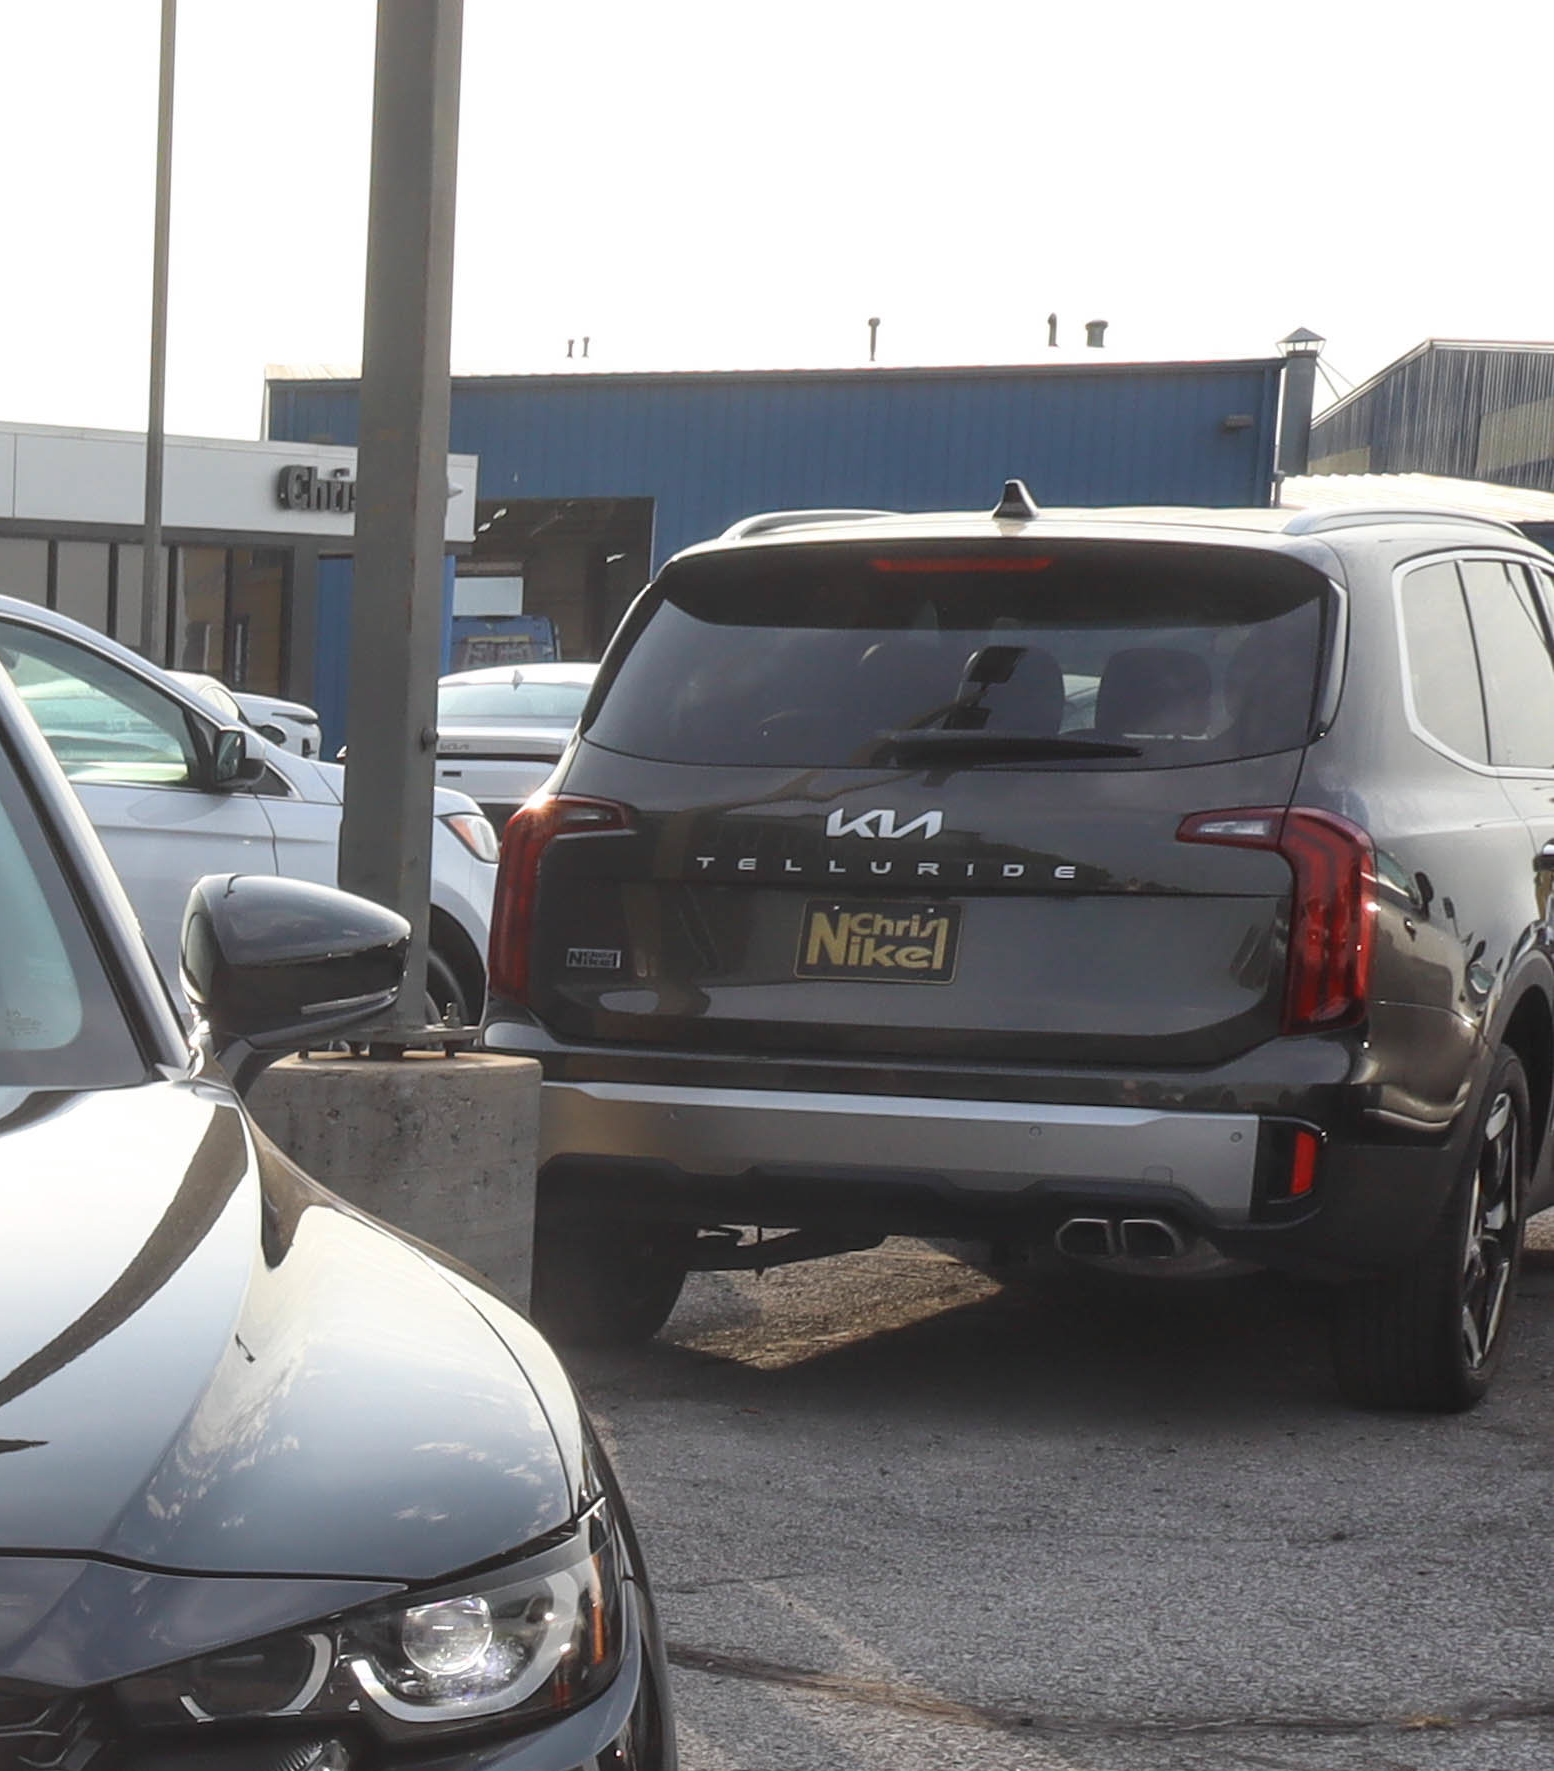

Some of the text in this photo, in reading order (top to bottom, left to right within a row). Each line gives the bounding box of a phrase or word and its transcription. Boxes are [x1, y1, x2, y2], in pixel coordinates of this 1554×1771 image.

[826, 808, 943, 839] KIA
[696, 856, 1077, 880] TELLURIDE
[849, 912, 937, 938] Chris
[806, 911, 949, 971] Nikel
